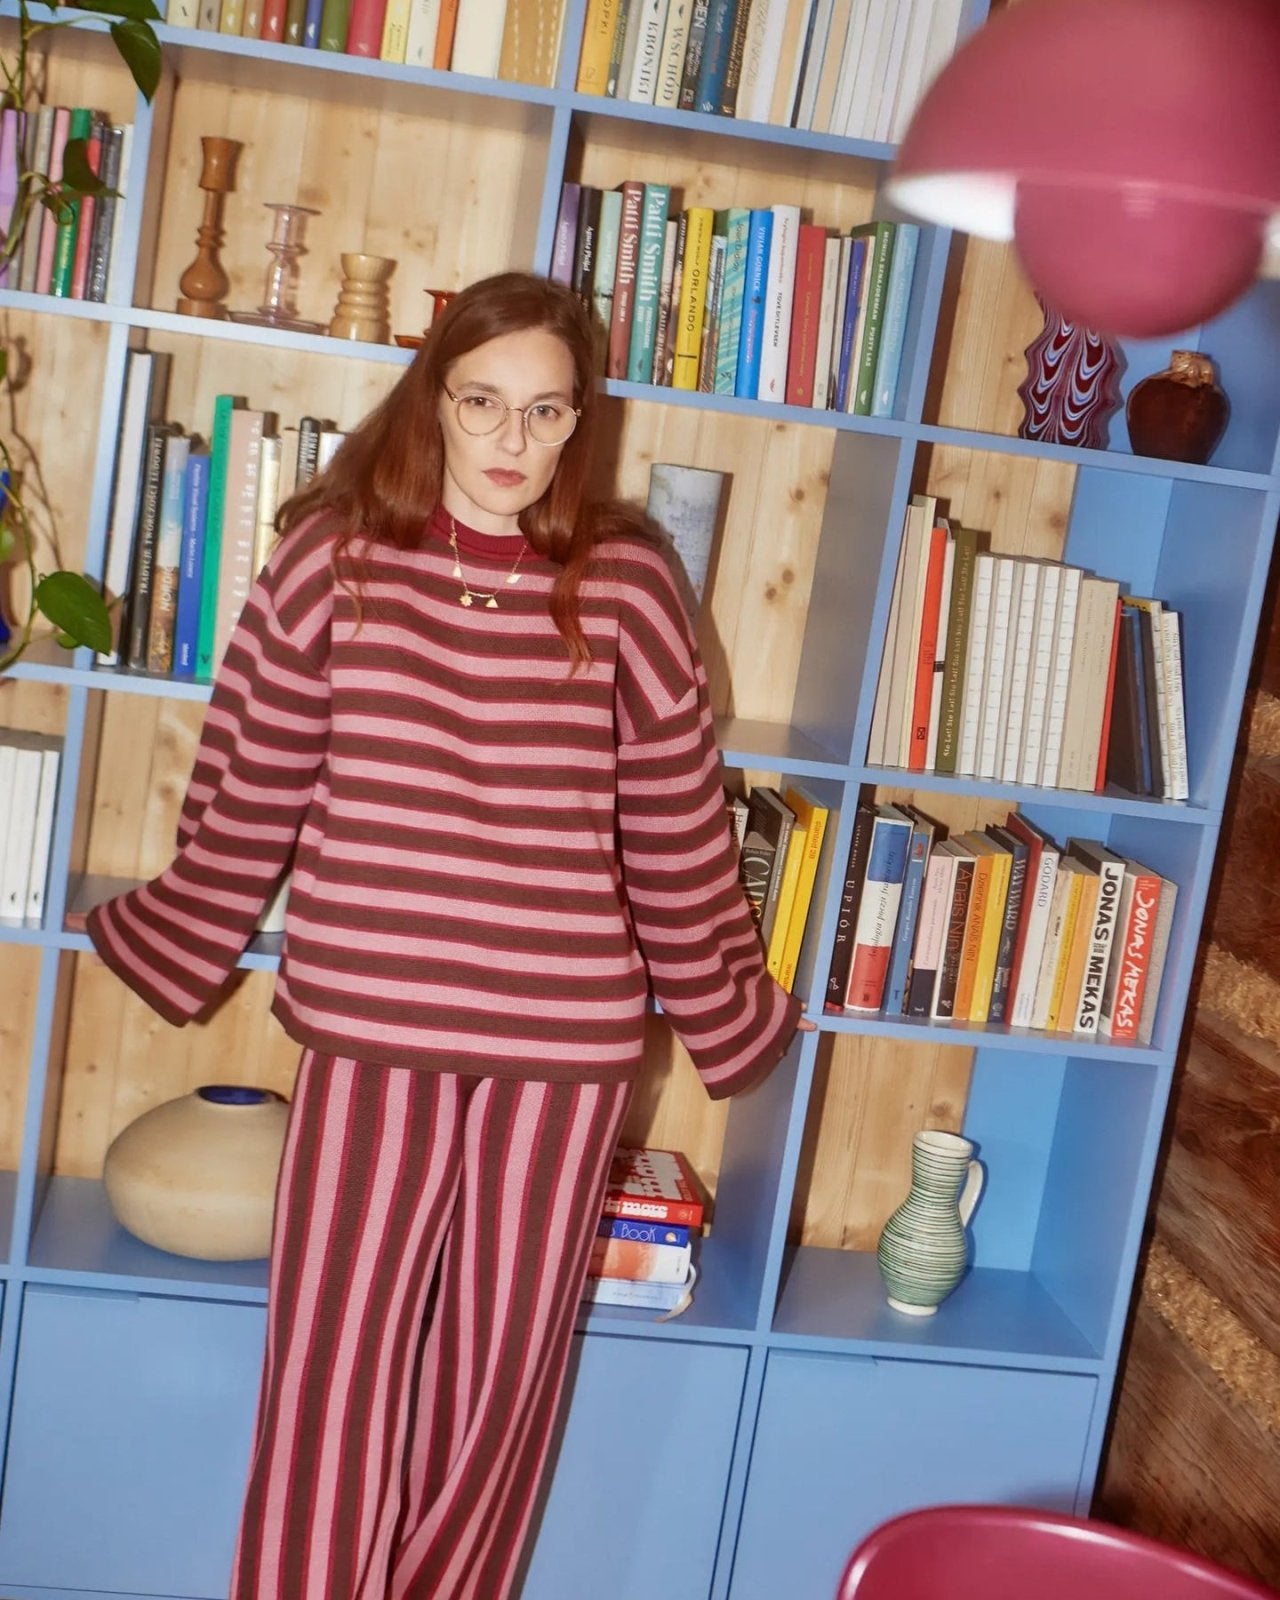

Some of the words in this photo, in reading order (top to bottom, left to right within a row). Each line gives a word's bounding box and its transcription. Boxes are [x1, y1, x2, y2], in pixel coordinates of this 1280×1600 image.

[637, 20, 658, 95] KRONIKI
[662, 26, 688, 102] WSCHÓD
[624, 188, 641, 229] Patti
[644, 190, 666, 237] Patti
[734, 222, 744, 242] Joan
[584, 226, 594, 250] Agneta
[618, 232, 637, 285] Smith
[731, 243, 742, 272] Didion
[756, 226, 765, 254] VIVIAN
[638, 242, 660, 302] Smith
[752, 255, 762, 292] GORNICK
[685, 268, 700, 332] ORLANDO
[864, 352, 872, 366] LAS
[866, 326, 876, 351] PUSTY
[139, 548, 153, 593] TRADYCJE
[158, 563, 175, 612] NORDIC
[974, 872, 987, 912] Dziennik
[1005, 857, 1026, 930] WAYWARD
[1036, 857, 1054, 908] GODARD
[1094, 866, 1119, 941] JONAS
[835, 879, 855, 944] UPIÓR
[874, 896, 887, 920] poezji
[1126, 890, 1155, 959] JONAS
[947, 919, 964, 951] Nin
[965, 944, 976, 961] NIN
[1078, 954, 1104, 1029] MEKAS
[1115, 960, 1144, 1029] MEKAS
